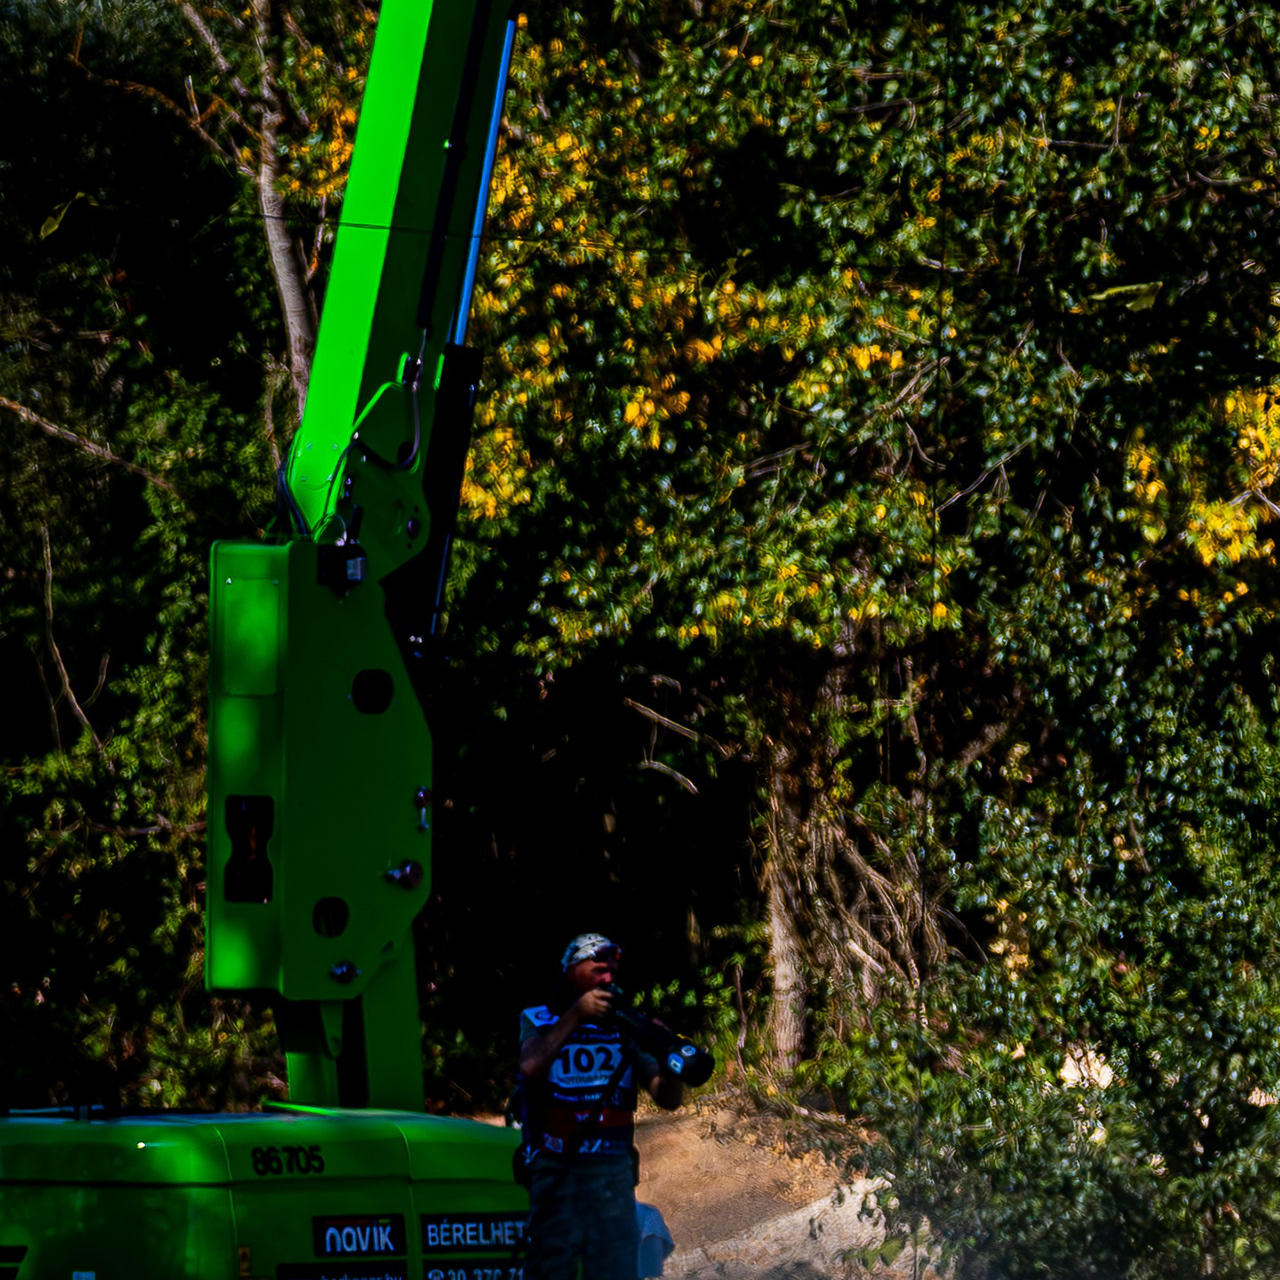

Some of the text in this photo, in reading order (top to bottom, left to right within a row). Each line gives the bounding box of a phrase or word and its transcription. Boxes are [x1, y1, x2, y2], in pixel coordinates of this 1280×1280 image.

[558, 1047, 615, 1074] 102
[251, 1145, 325, 1176] 86705
[428, 1218, 530, 1246] BÉRELHET
